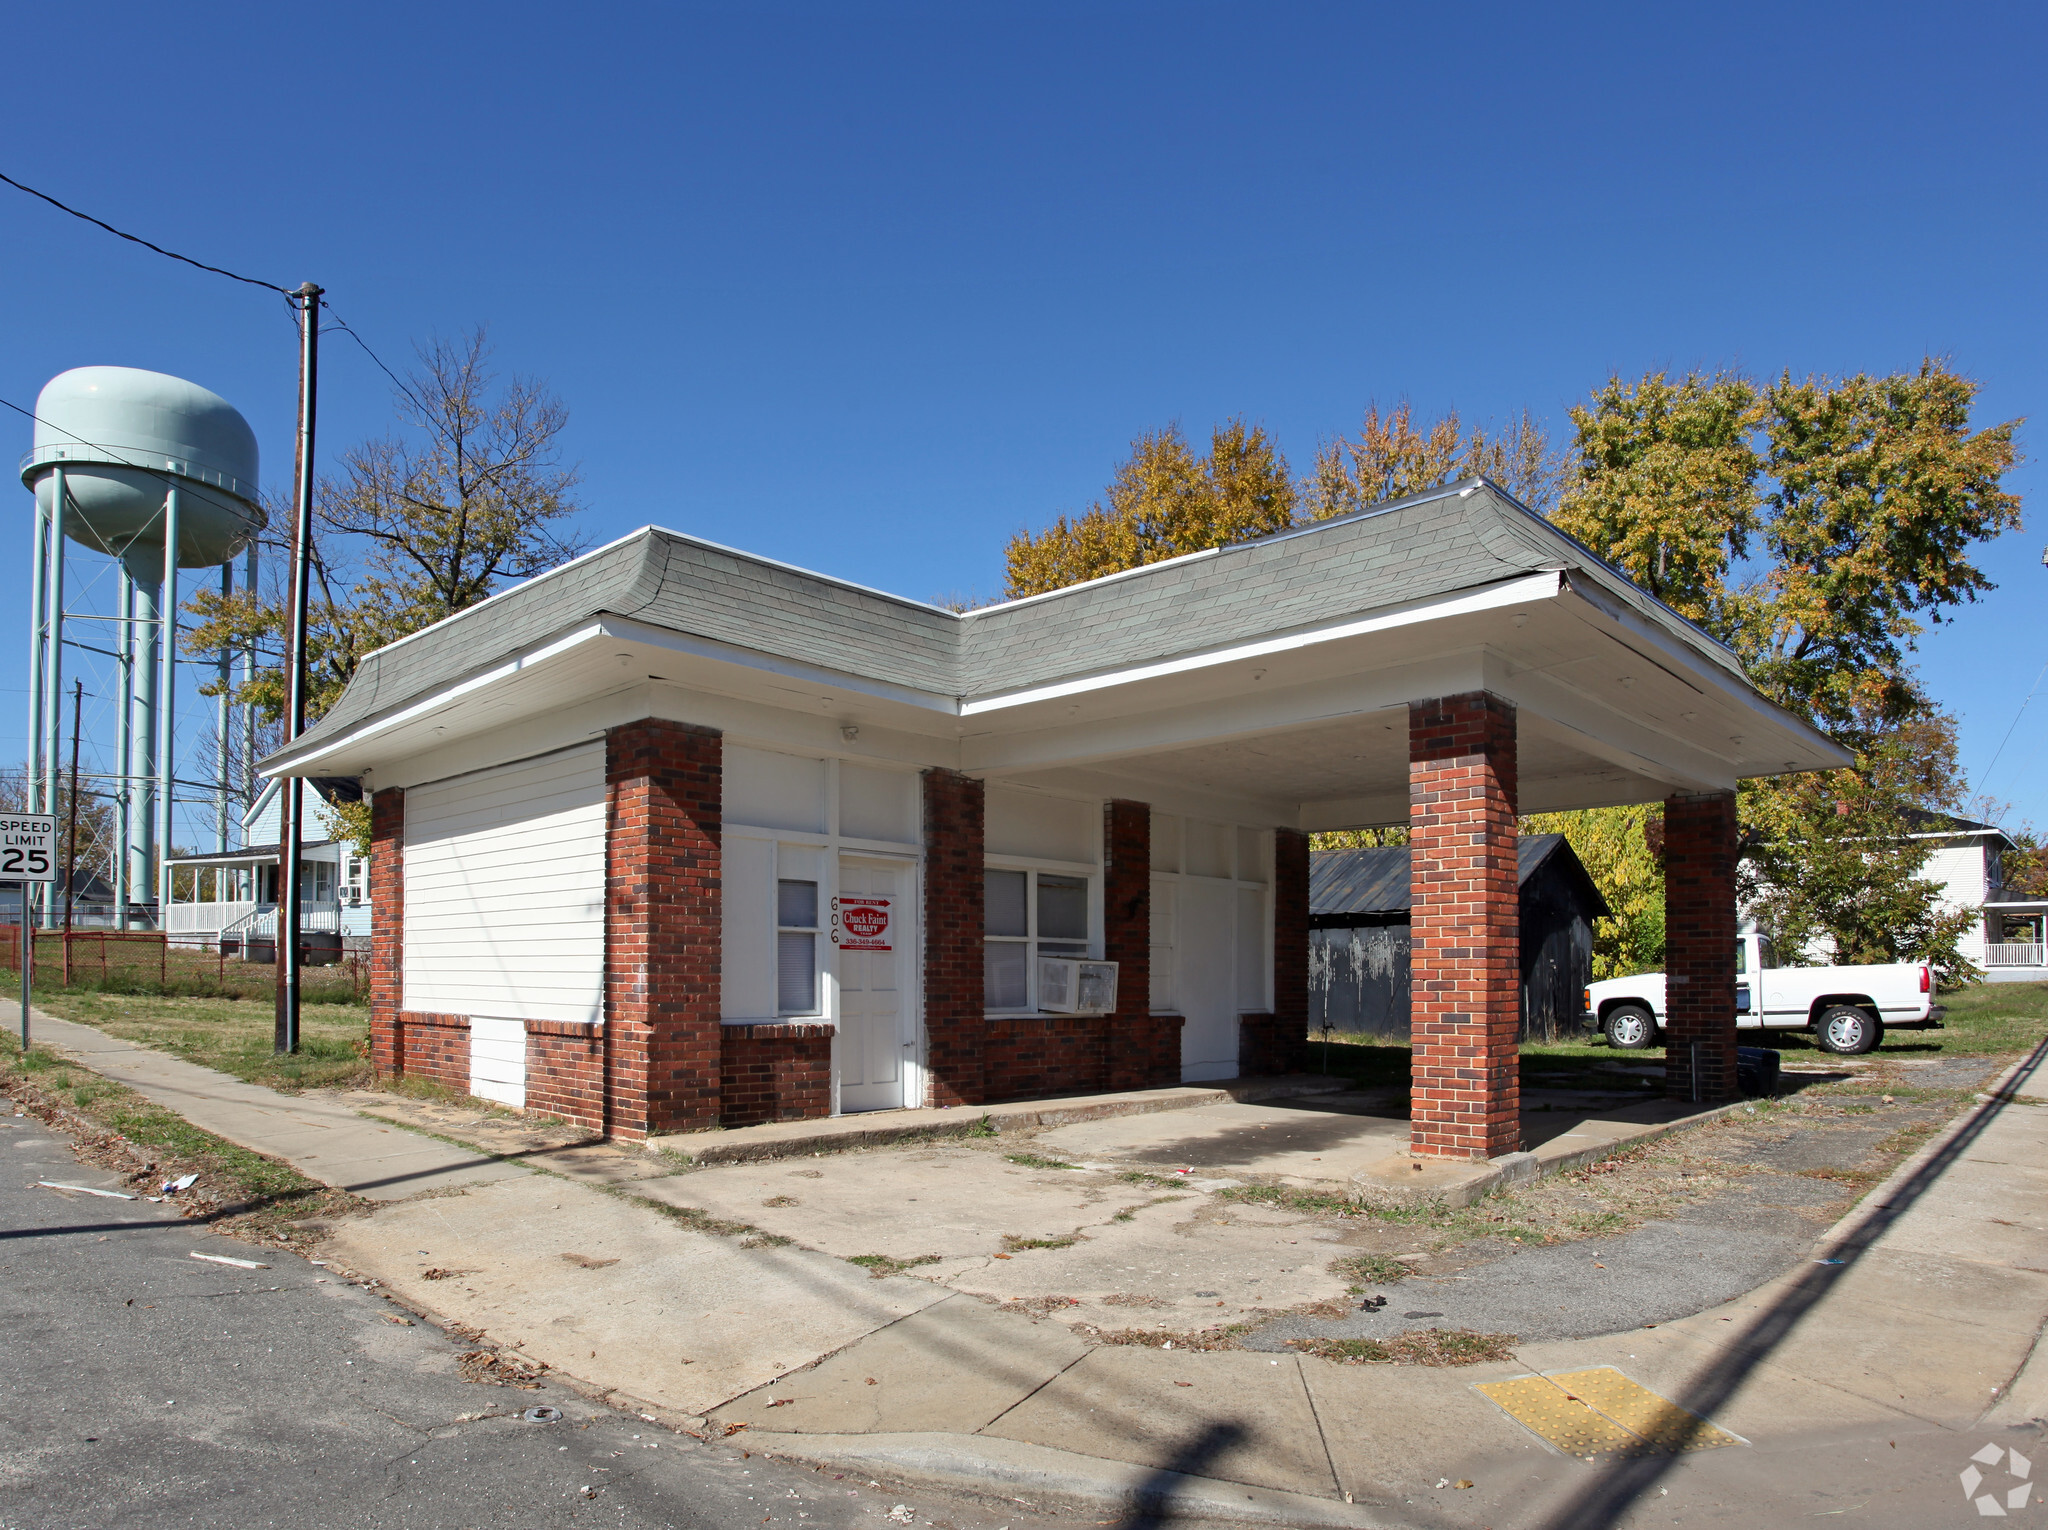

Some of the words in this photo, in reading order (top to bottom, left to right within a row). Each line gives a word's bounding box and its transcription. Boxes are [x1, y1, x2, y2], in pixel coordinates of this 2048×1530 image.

[0, 820, 51, 833] SPEED
[5, 834, 46, 846] LIMIT
[2, 848, 50, 874] 25
[831, 896, 839, 943] 606
[844, 912, 866, 924] Chuck
[868, 913, 887, 925] Faint
